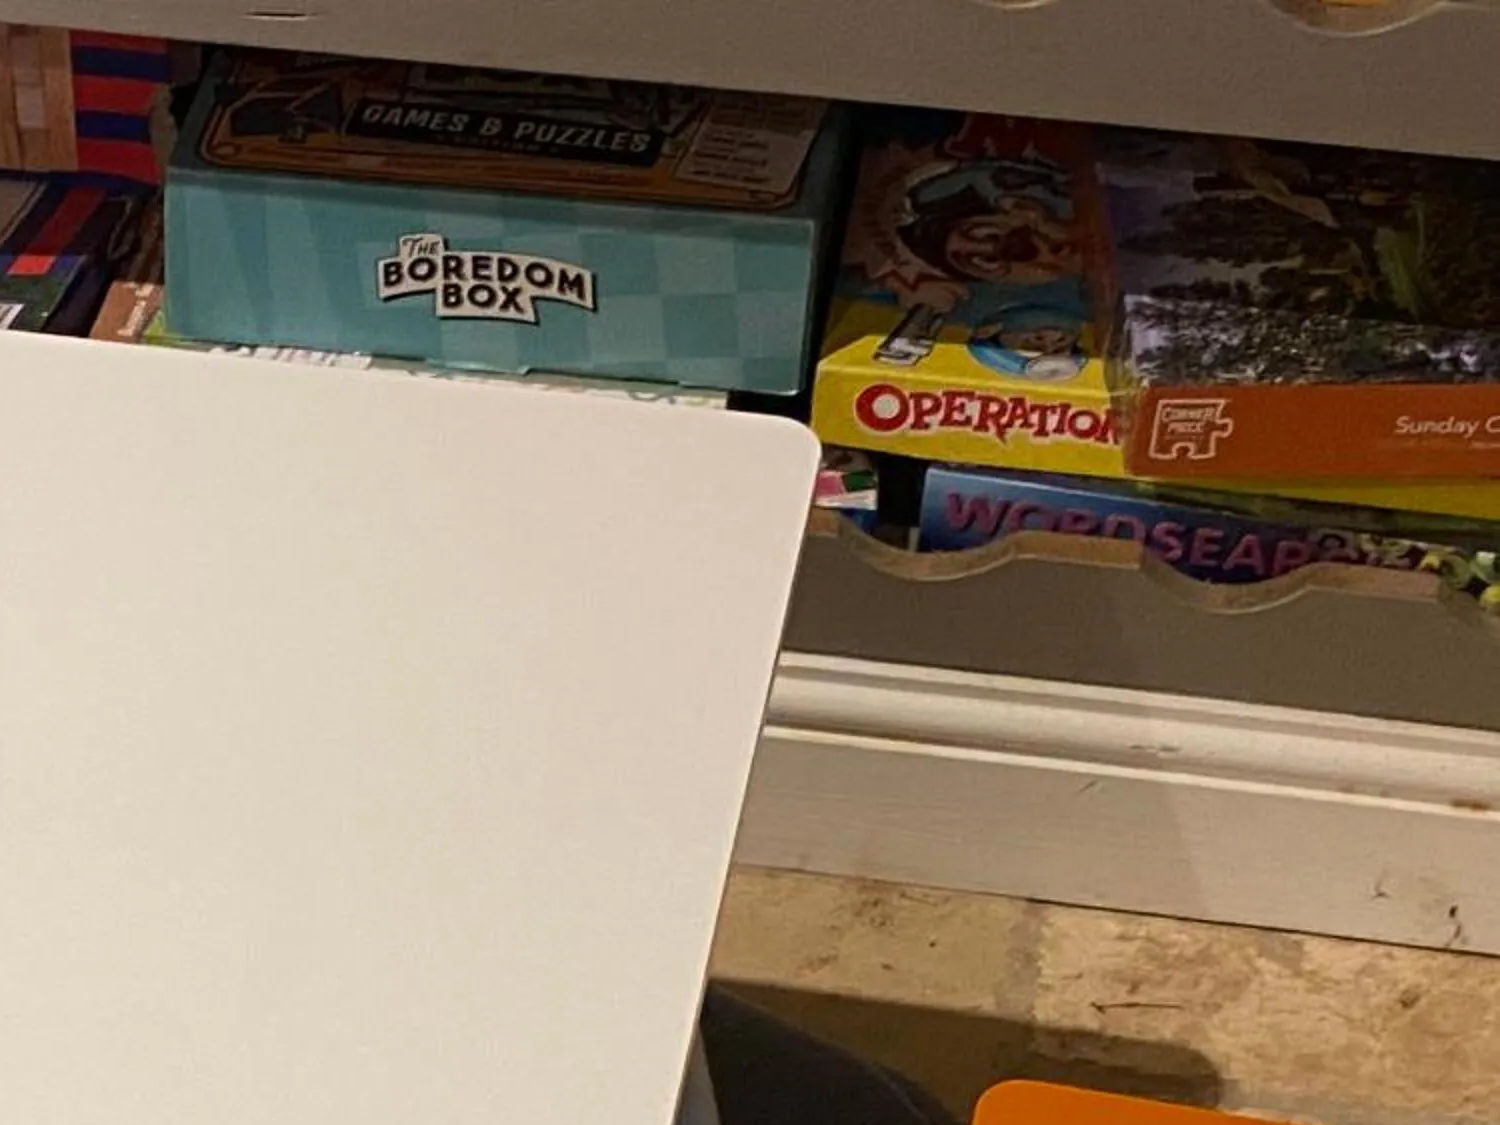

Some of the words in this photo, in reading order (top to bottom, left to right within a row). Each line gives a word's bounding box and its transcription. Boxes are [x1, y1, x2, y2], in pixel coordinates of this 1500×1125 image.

[361, 103, 466, 134] GAMES
[513, 120, 653, 154] PUZZLES
[383, 255, 587, 301] BOREDOM
[442, 283, 525, 314] BOX
[1395, 415, 1479, 439] Sunday
